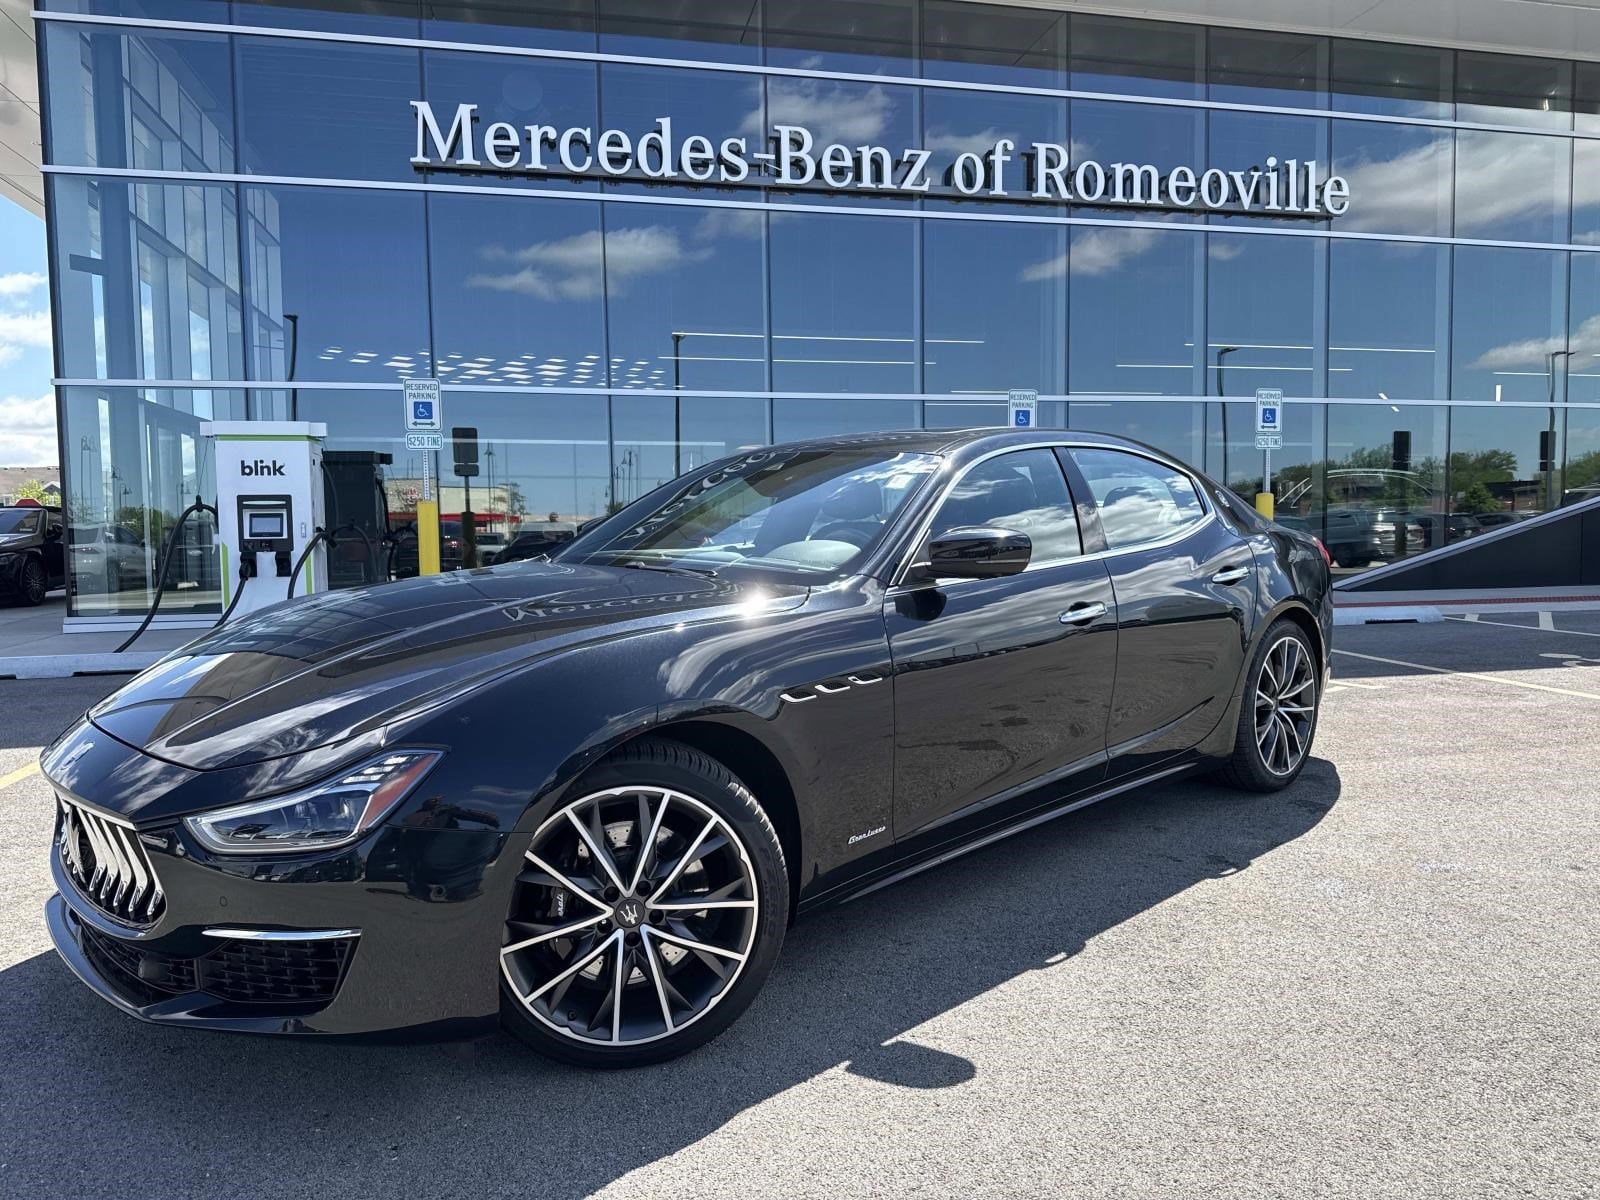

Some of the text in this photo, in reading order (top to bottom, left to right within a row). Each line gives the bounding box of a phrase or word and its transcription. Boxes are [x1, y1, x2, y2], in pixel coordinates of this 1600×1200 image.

[410, 101, 1351, 215] Mercedes-Benz of Romeoville
[406, 383, 438, 391] RESERVED
[408, 436, 441, 447] $250 FINE
[240, 459, 286, 477] blink
